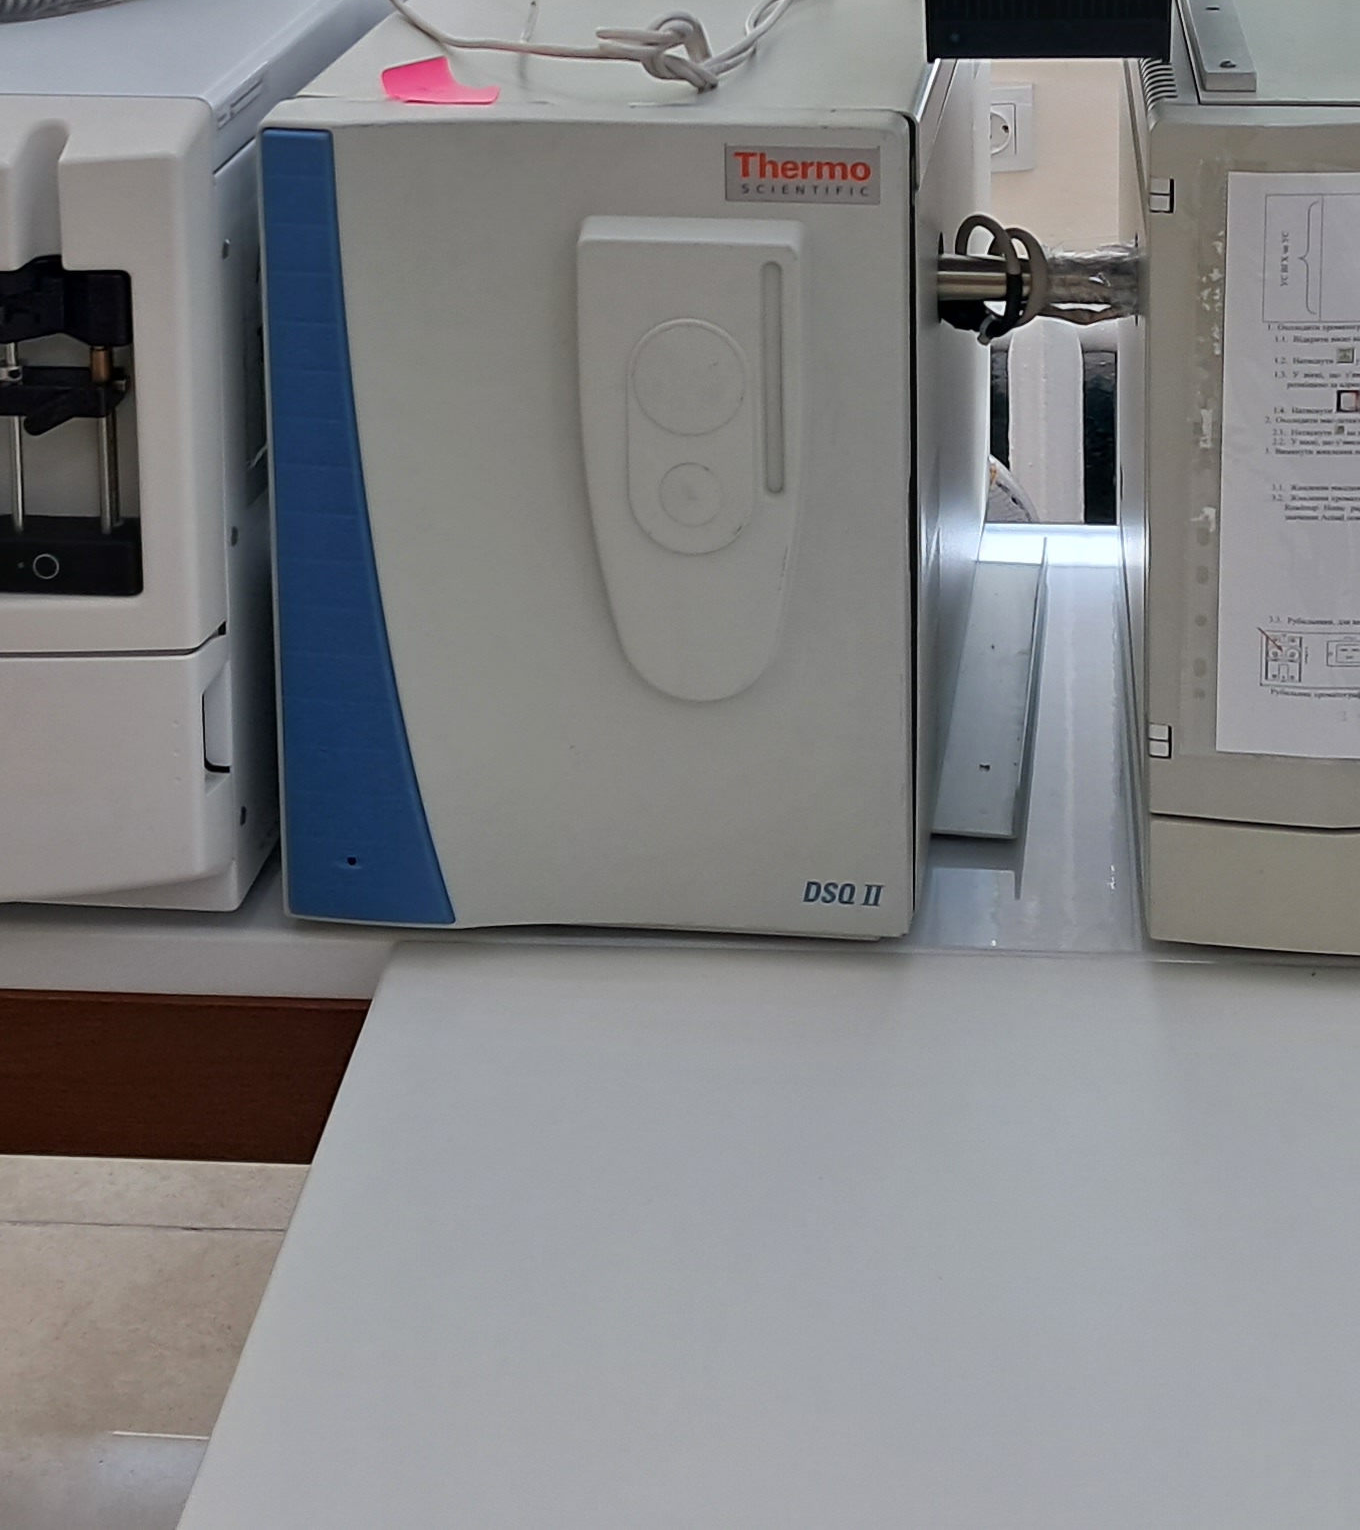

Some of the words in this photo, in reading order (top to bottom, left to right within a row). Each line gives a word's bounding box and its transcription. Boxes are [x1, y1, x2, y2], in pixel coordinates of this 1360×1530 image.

[734, 151, 872, 181] Thermo
[742, 183, 870, 197] SCIENTIFIC
[803, 881, 856, 904] DSQ
[861, 883, 885, 907] II
